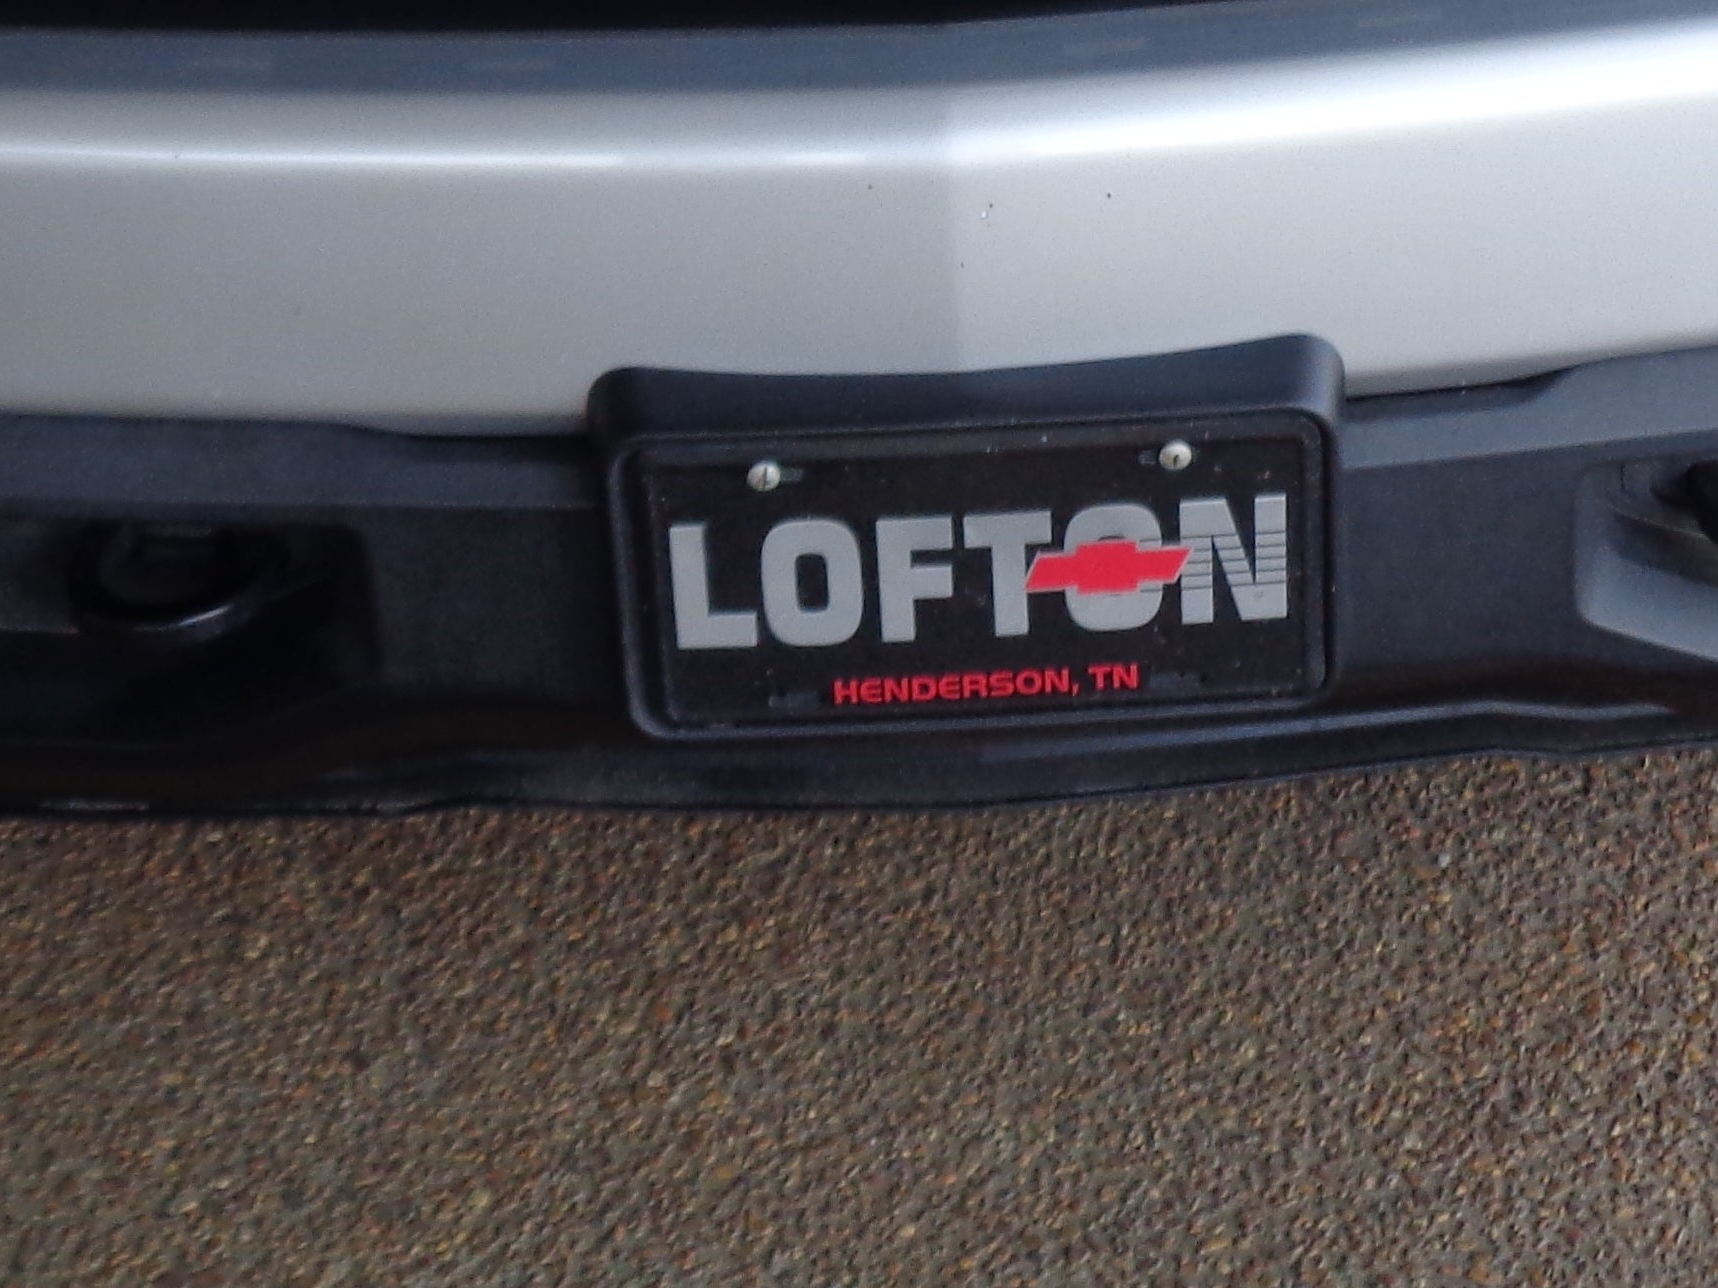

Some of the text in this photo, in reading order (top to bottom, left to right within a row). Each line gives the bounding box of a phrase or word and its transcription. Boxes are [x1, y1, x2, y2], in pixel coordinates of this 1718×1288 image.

[668, 493, 1288, 650] LOFTON
[833, 663, 1140, 705] HENDERSON, TN
